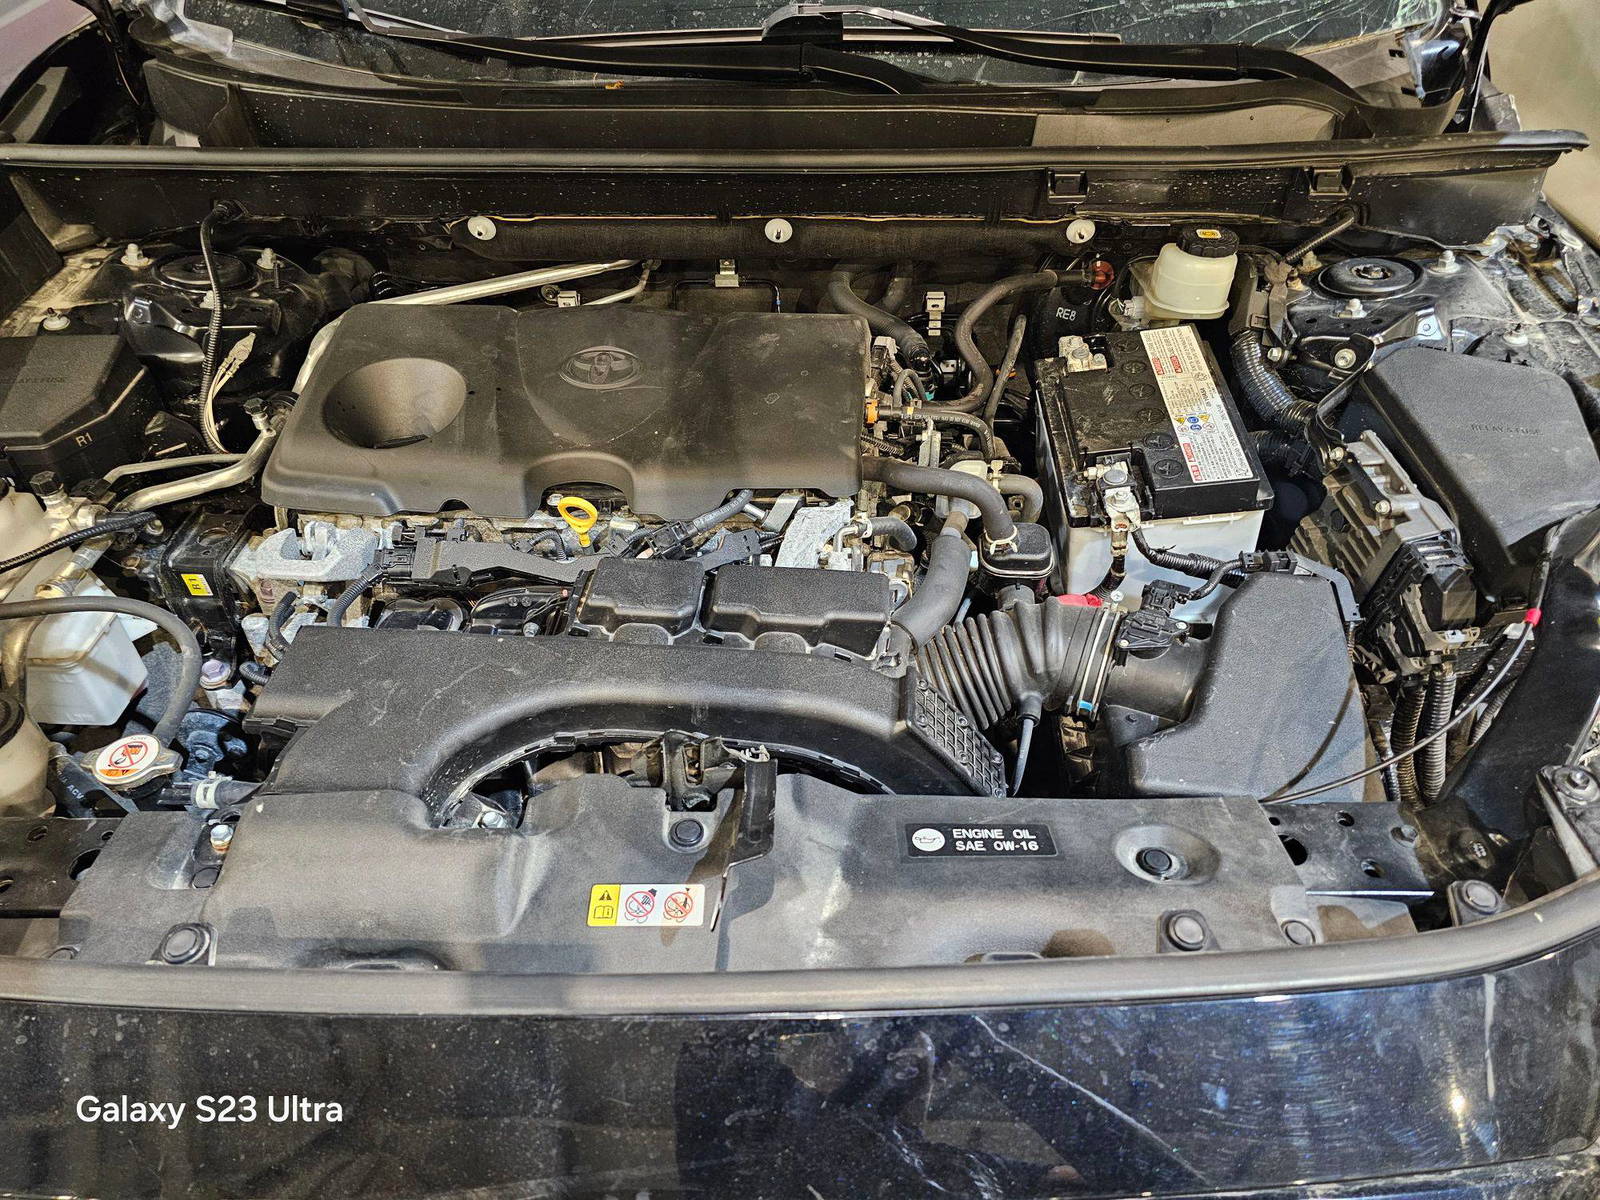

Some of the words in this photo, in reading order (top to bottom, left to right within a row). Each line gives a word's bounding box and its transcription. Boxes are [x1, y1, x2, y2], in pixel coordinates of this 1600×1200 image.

[1055, 306, 1077, 321] RE8
[75, 432, 93, 447] R1
[952, 828, 1004, 839] ENGINE
[1012, 829, 1036, 839] OIL
[955, 841, 986, 851] SAE
[993, 840, 1039, 851] 0W-16
